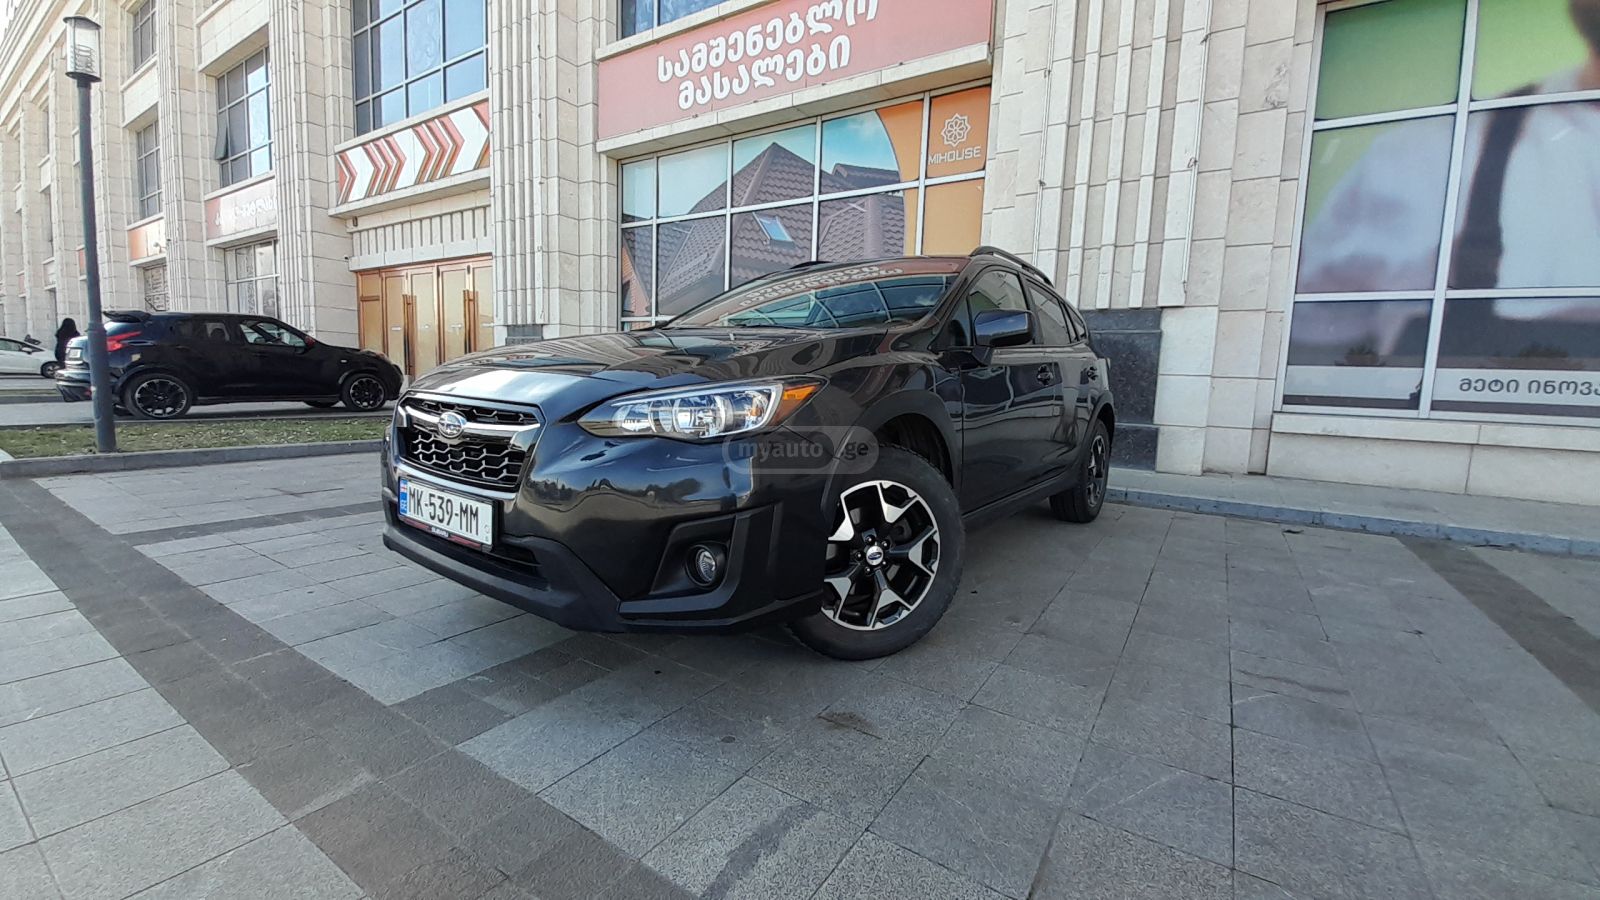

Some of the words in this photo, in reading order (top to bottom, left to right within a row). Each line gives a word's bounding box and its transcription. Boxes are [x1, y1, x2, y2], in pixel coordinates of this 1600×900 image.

[678, 34, 851, 110] მასალები
[928, 146, 981, 165] MIHOUSE
[1459, 378, 1520, 393] მეტი
[409, 486, 479, 536] MK-539-MM
